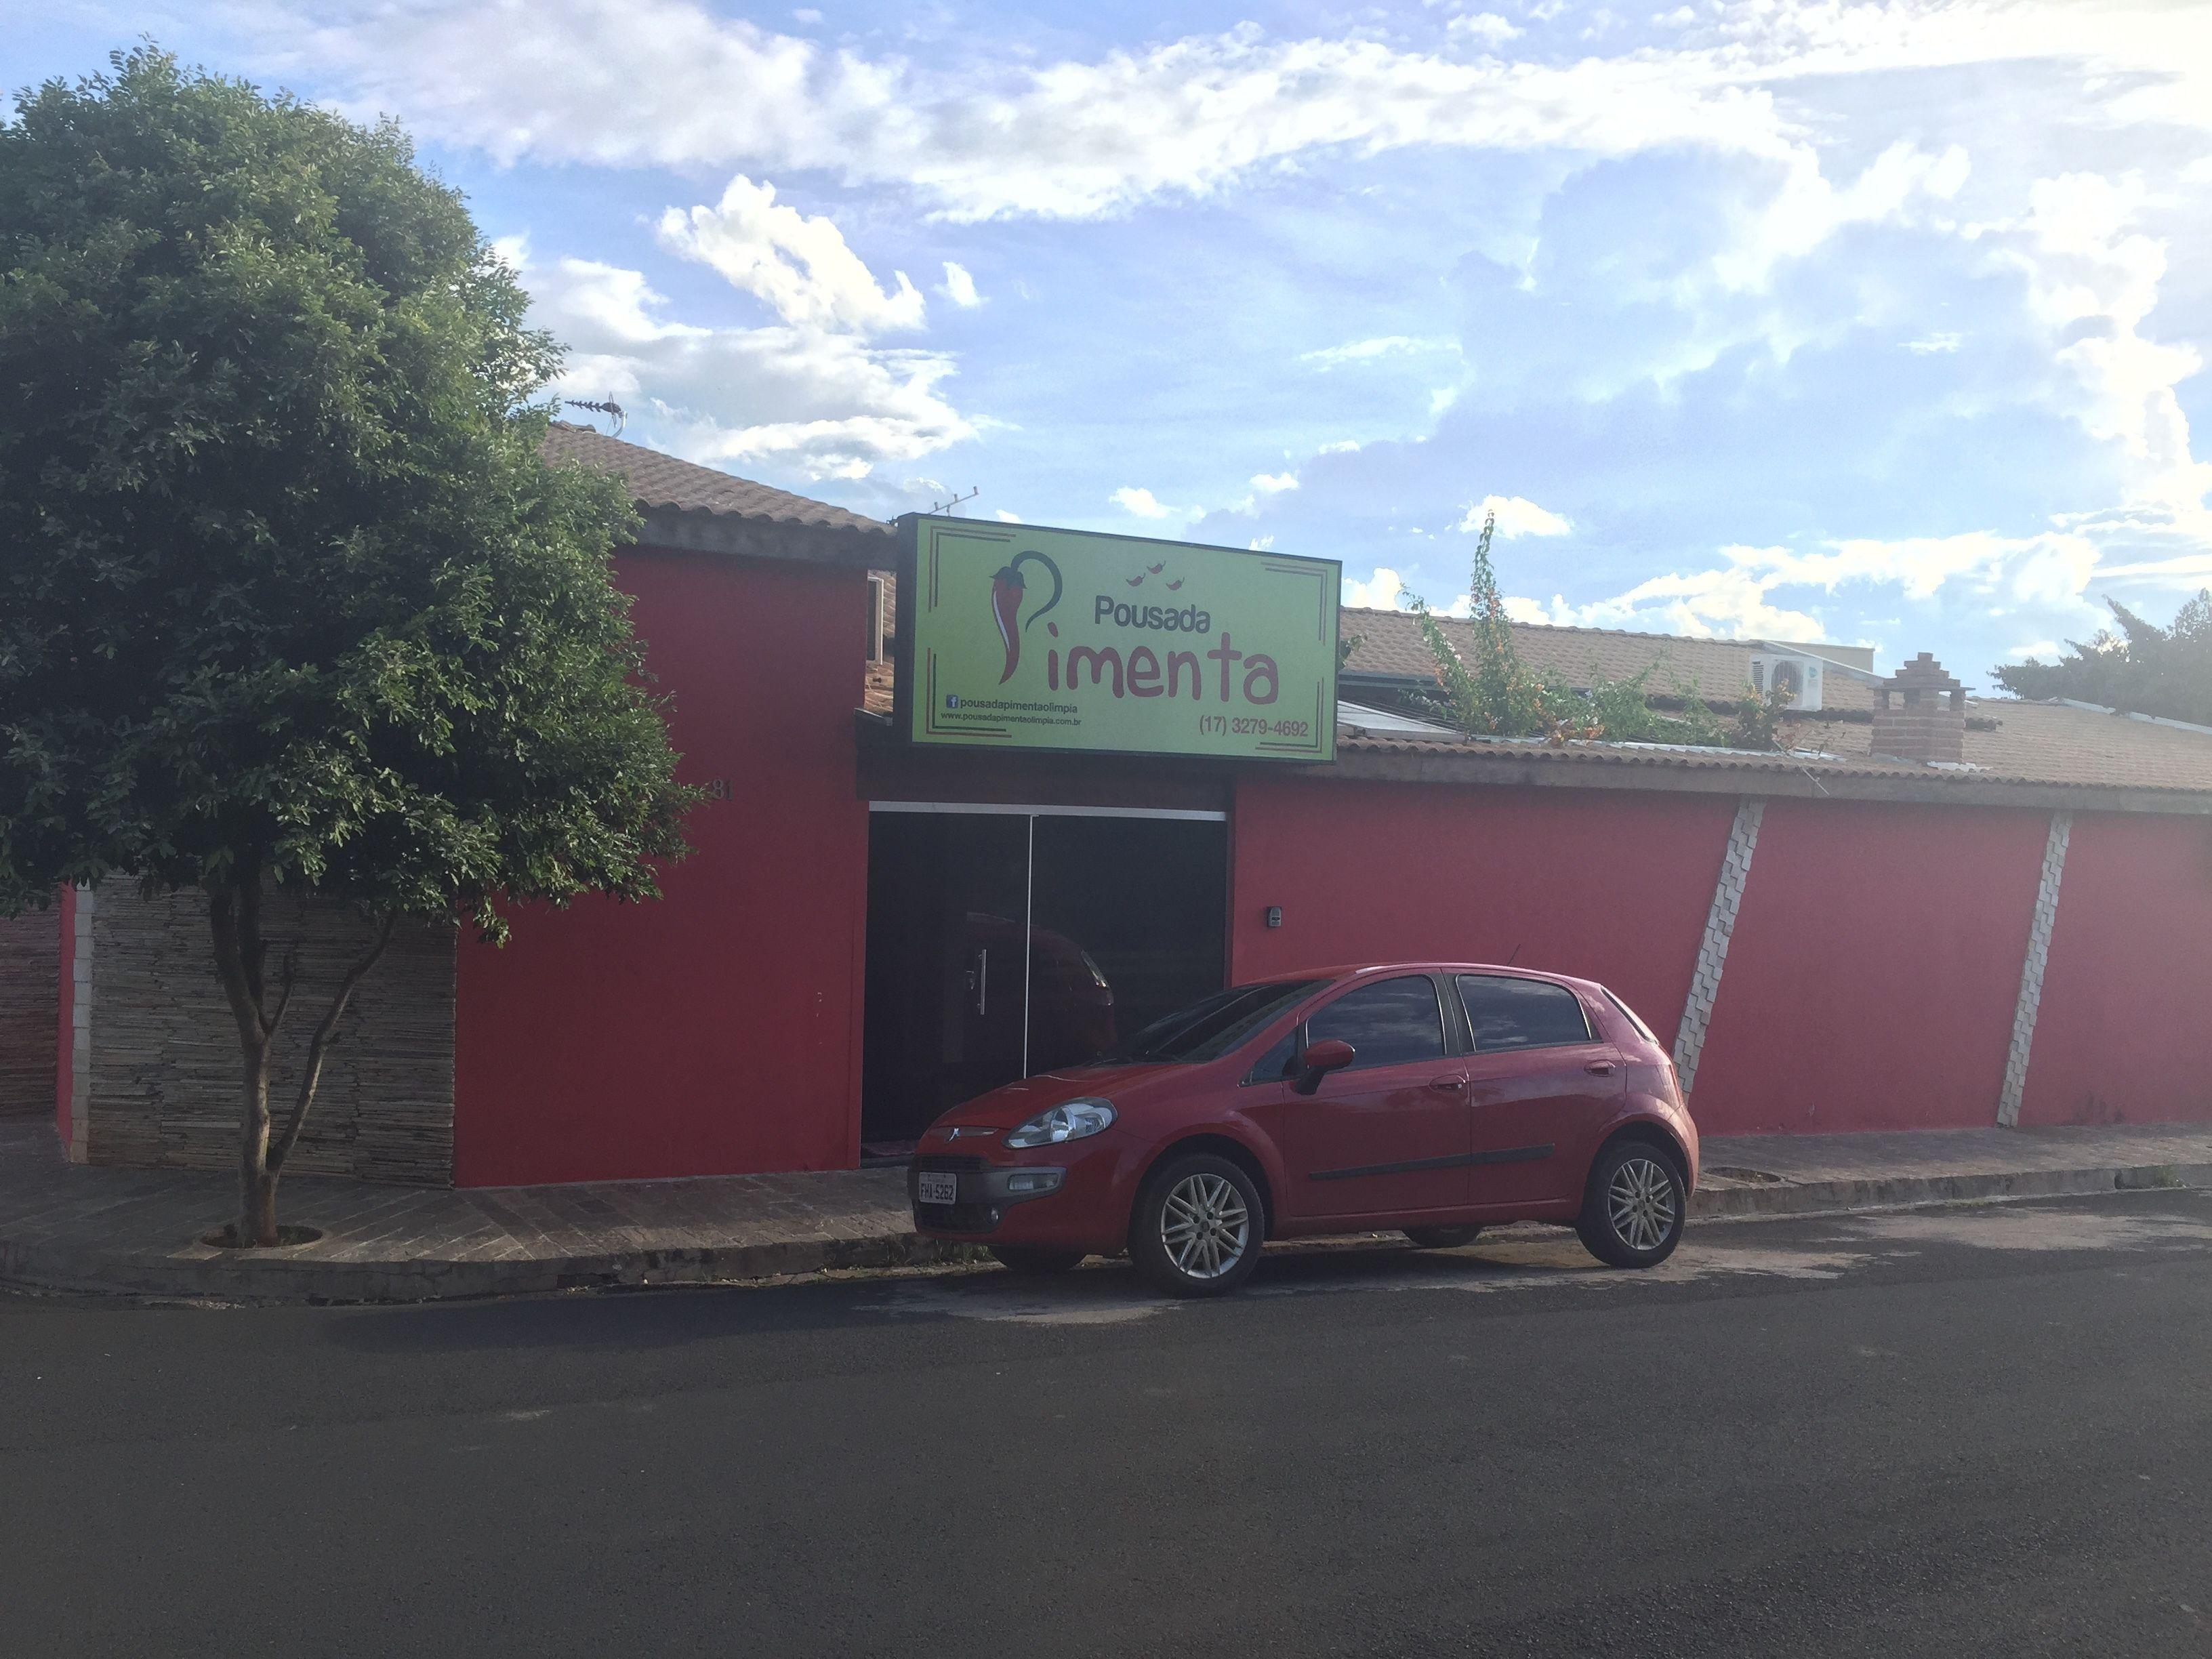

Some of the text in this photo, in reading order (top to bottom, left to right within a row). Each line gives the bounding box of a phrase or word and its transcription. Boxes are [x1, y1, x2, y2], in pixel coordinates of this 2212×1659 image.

[1094, 594, 1211, 634] Pousada
[960, 699, 1078, 714] pousadapimentaolimpia
[941, 712, 1082, 726] www.pousadapimentaolimpia.com.br
[1200, 714, 1309, 737] (17) 3279-4692
